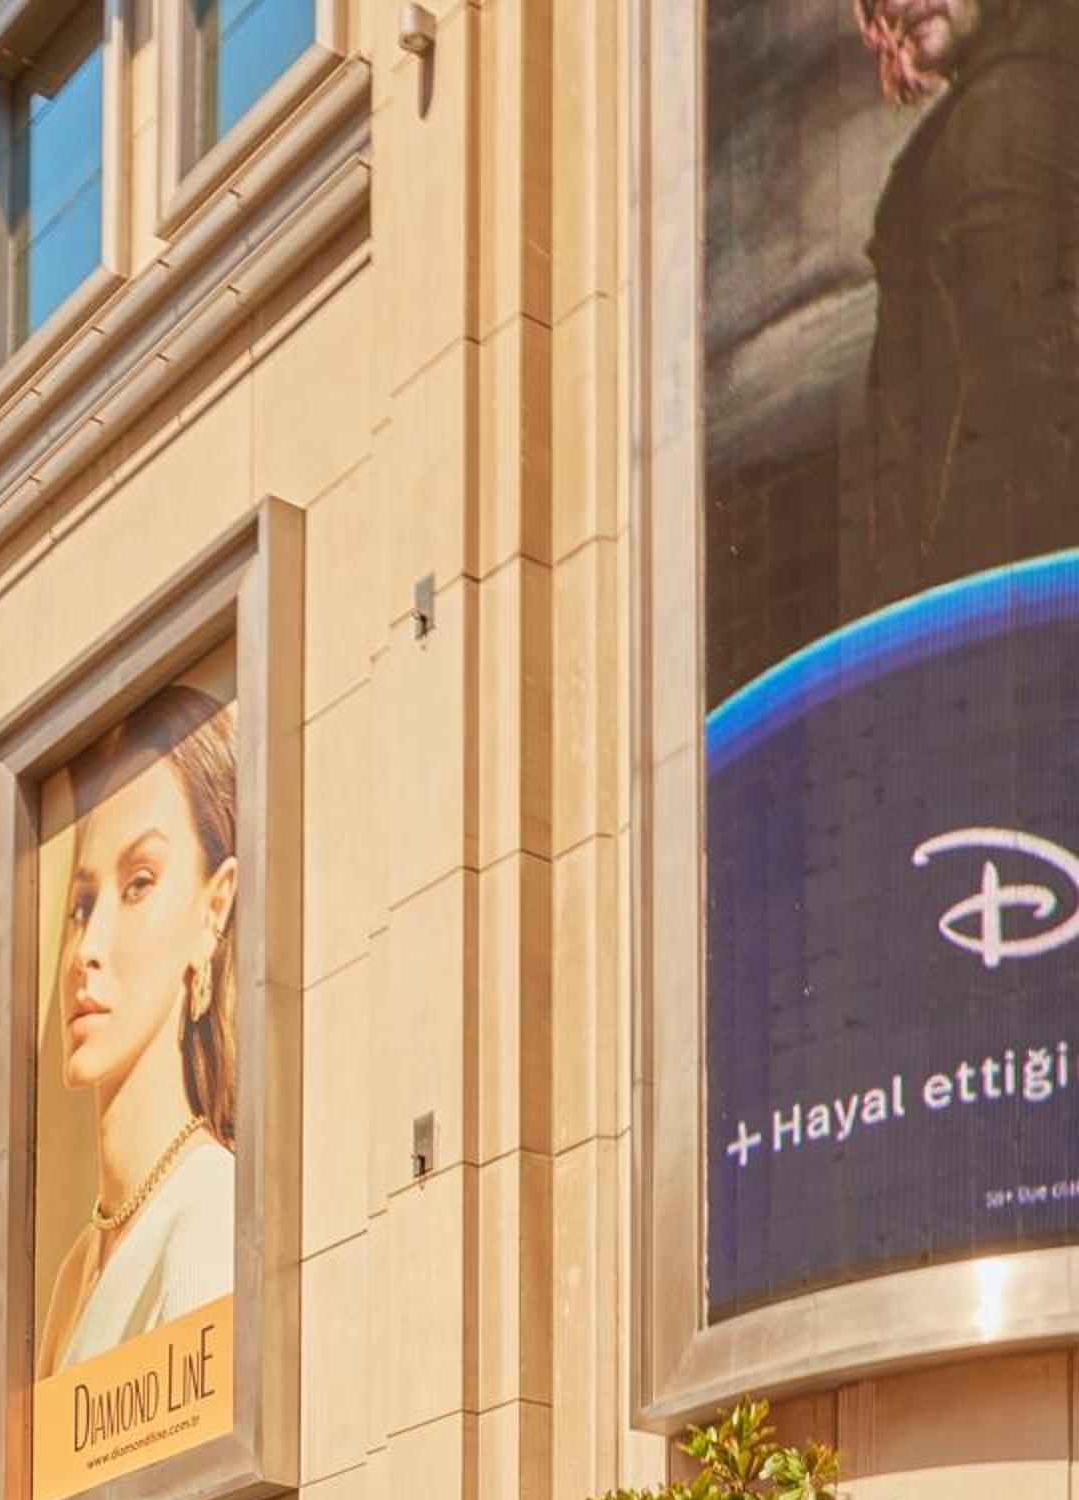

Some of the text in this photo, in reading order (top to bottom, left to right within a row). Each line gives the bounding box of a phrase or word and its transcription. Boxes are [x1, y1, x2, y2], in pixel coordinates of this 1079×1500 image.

[773, 1074, 906, 1153] Hayal
[923, 1040, 1069, 1109] ettiği
[74, 1324, 216, 1453] DIAMOND LINE
